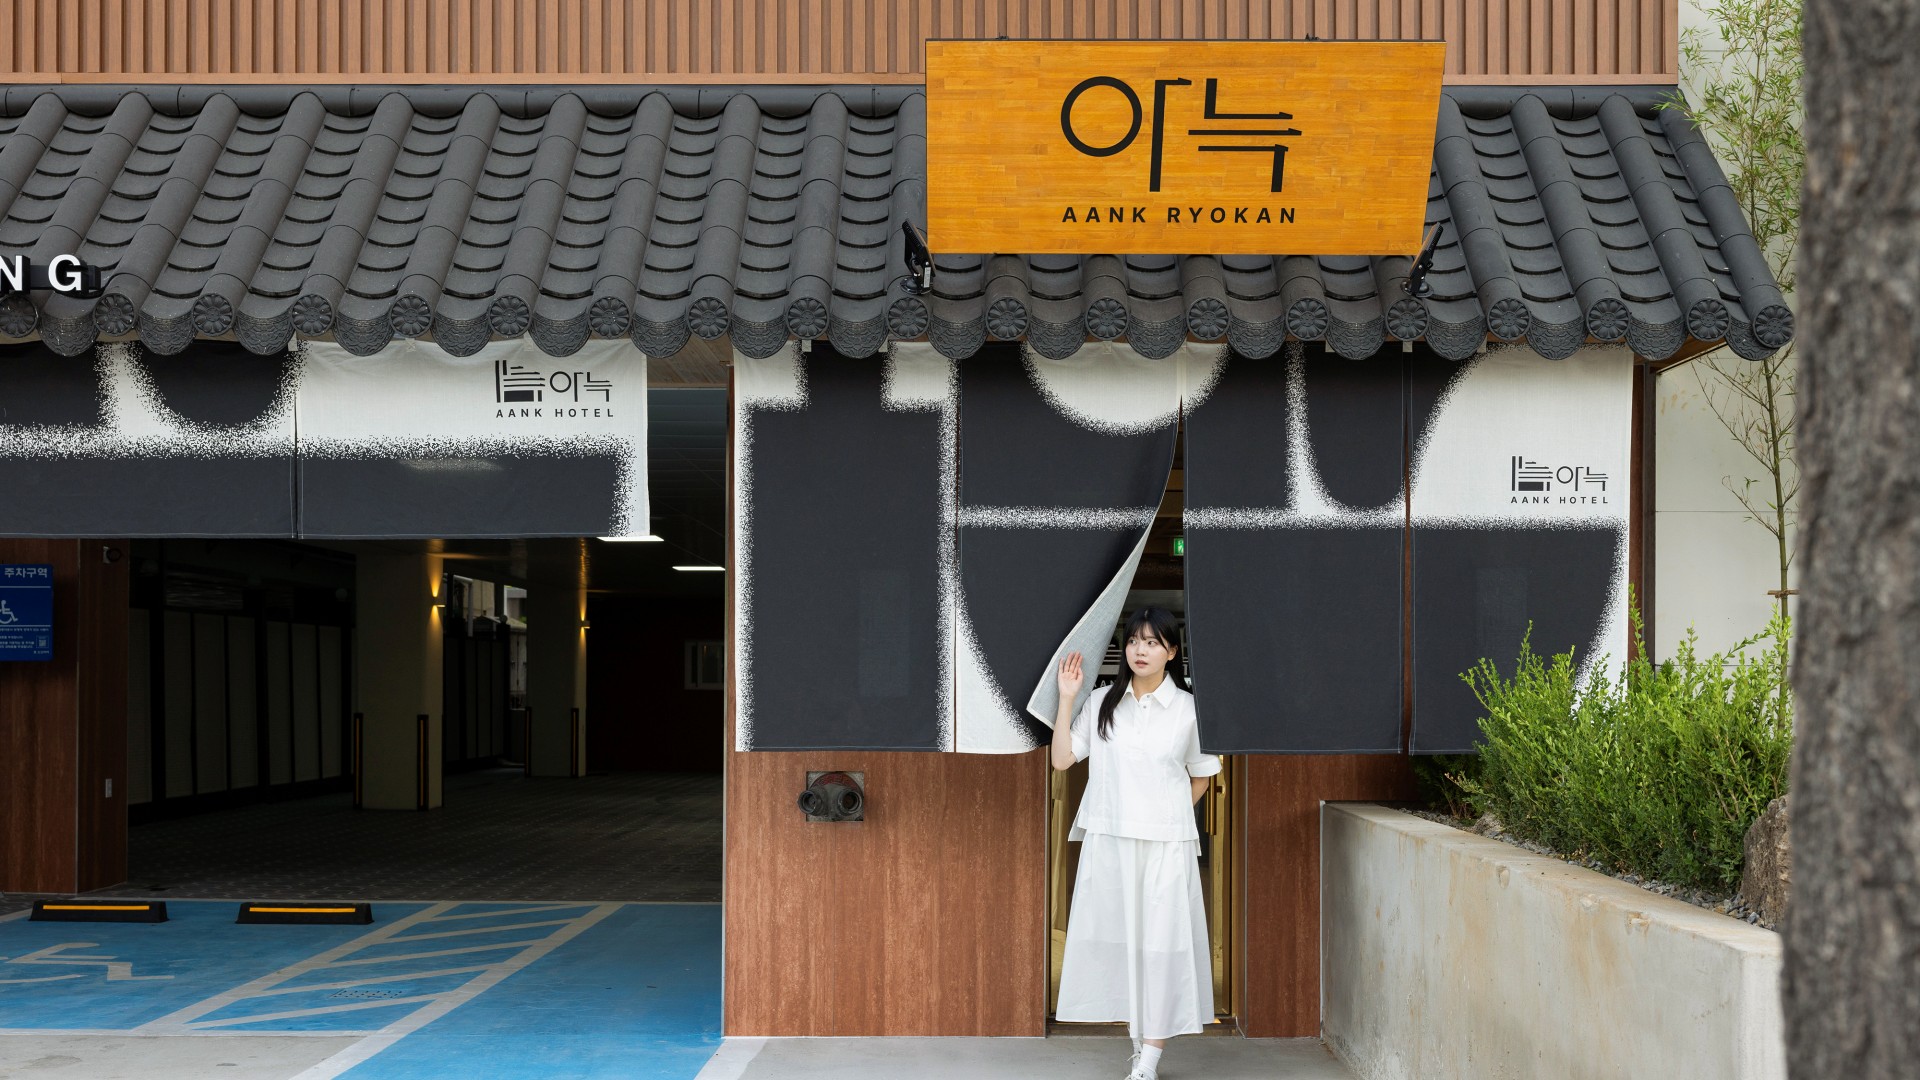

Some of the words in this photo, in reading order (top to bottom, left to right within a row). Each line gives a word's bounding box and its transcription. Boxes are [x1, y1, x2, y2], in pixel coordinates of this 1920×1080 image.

[1062, 207, 1147, 223] AANK
[1167, 207, 1296, 224] RYOKAN
[0, 254, 82, 292] NG
[496, 408, 543, 418] AANK
[555, 408, 614, 418] HOTEL
[1510, 496, 1550, 504] AANK
[1559, 496, 1608, 504] HOTEL
[4, 567, 48, 578] 주차구역
